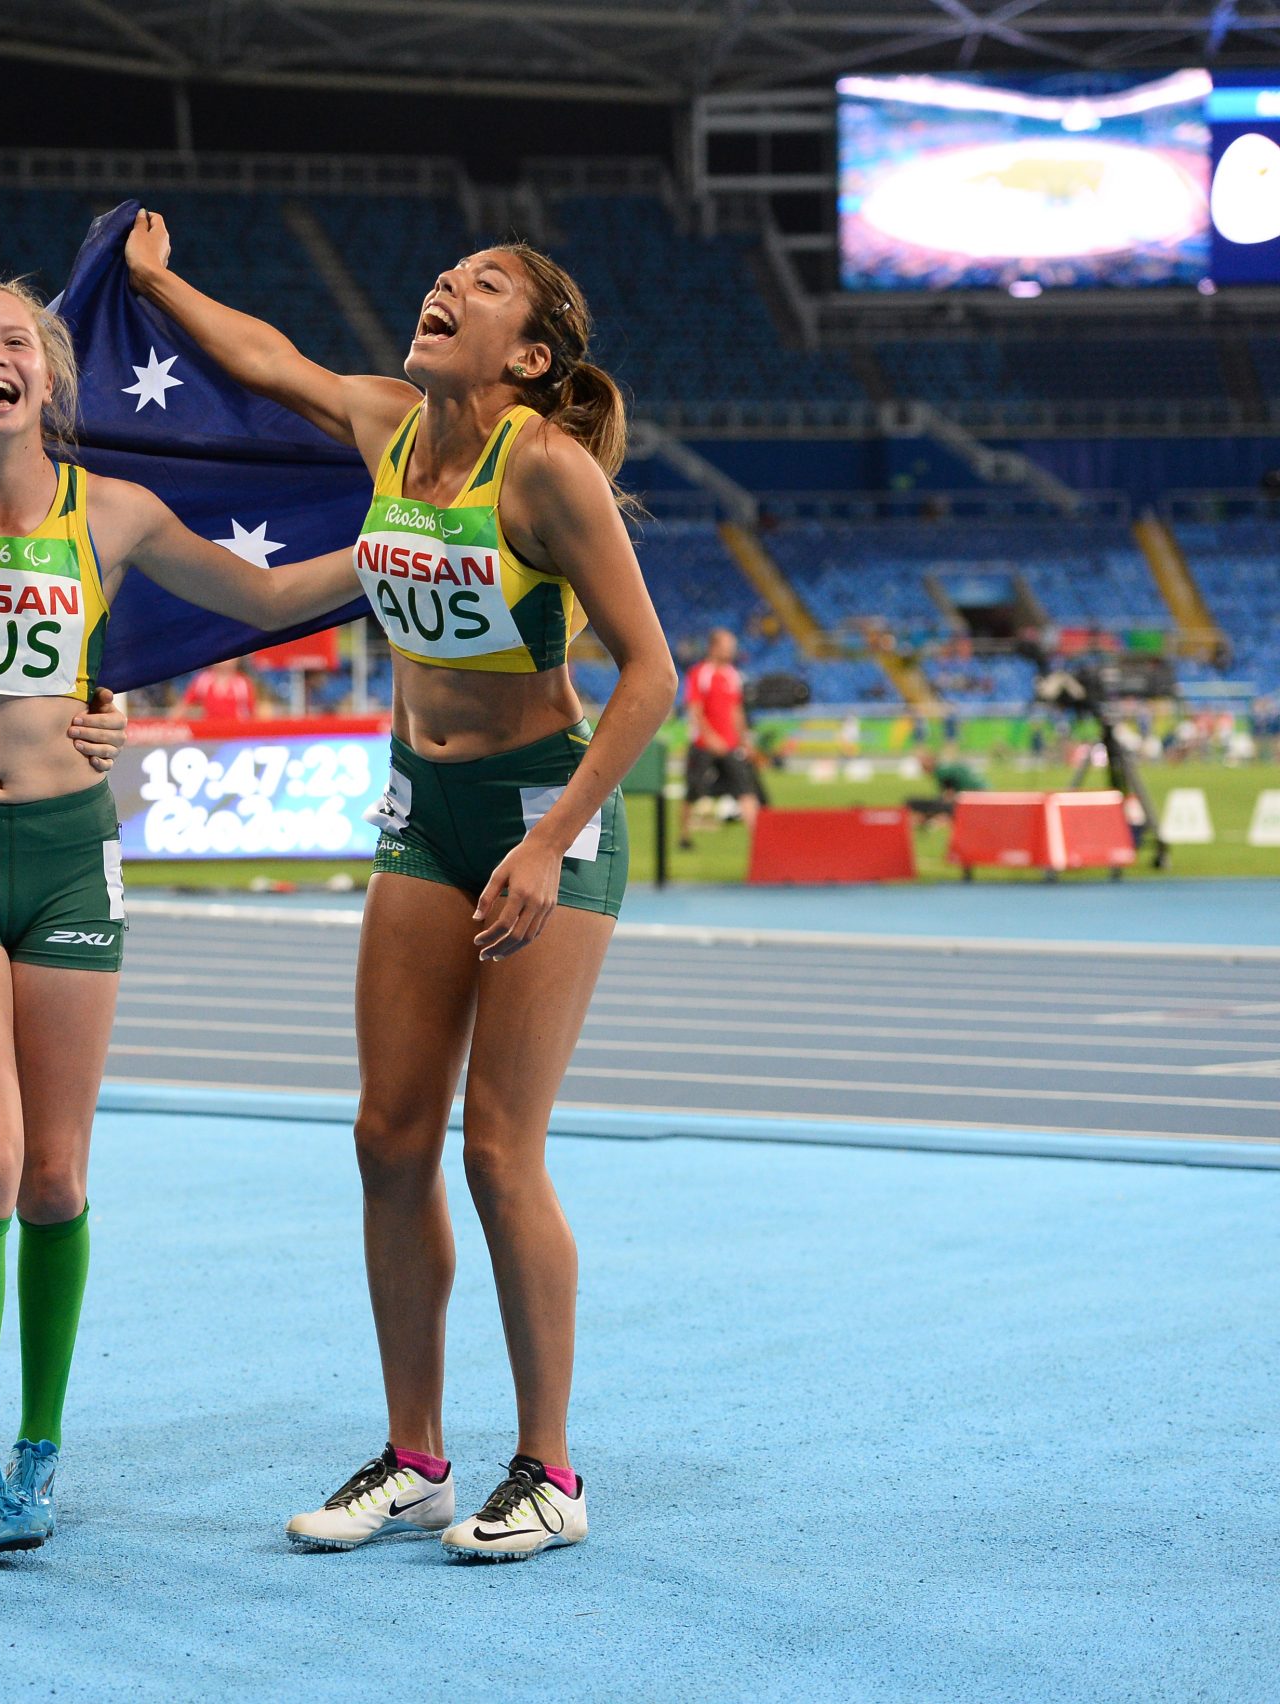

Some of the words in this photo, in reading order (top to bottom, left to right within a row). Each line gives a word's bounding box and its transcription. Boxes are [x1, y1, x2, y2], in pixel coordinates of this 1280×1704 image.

[385, 504, 436, 531] Rio2016
[357, 540, 495, 586] NISSAN
[377, 579, 491, 641] AUS
[141, 744, 370, 800] 19:47:23
[45, 930, 115, 946] 2XU
